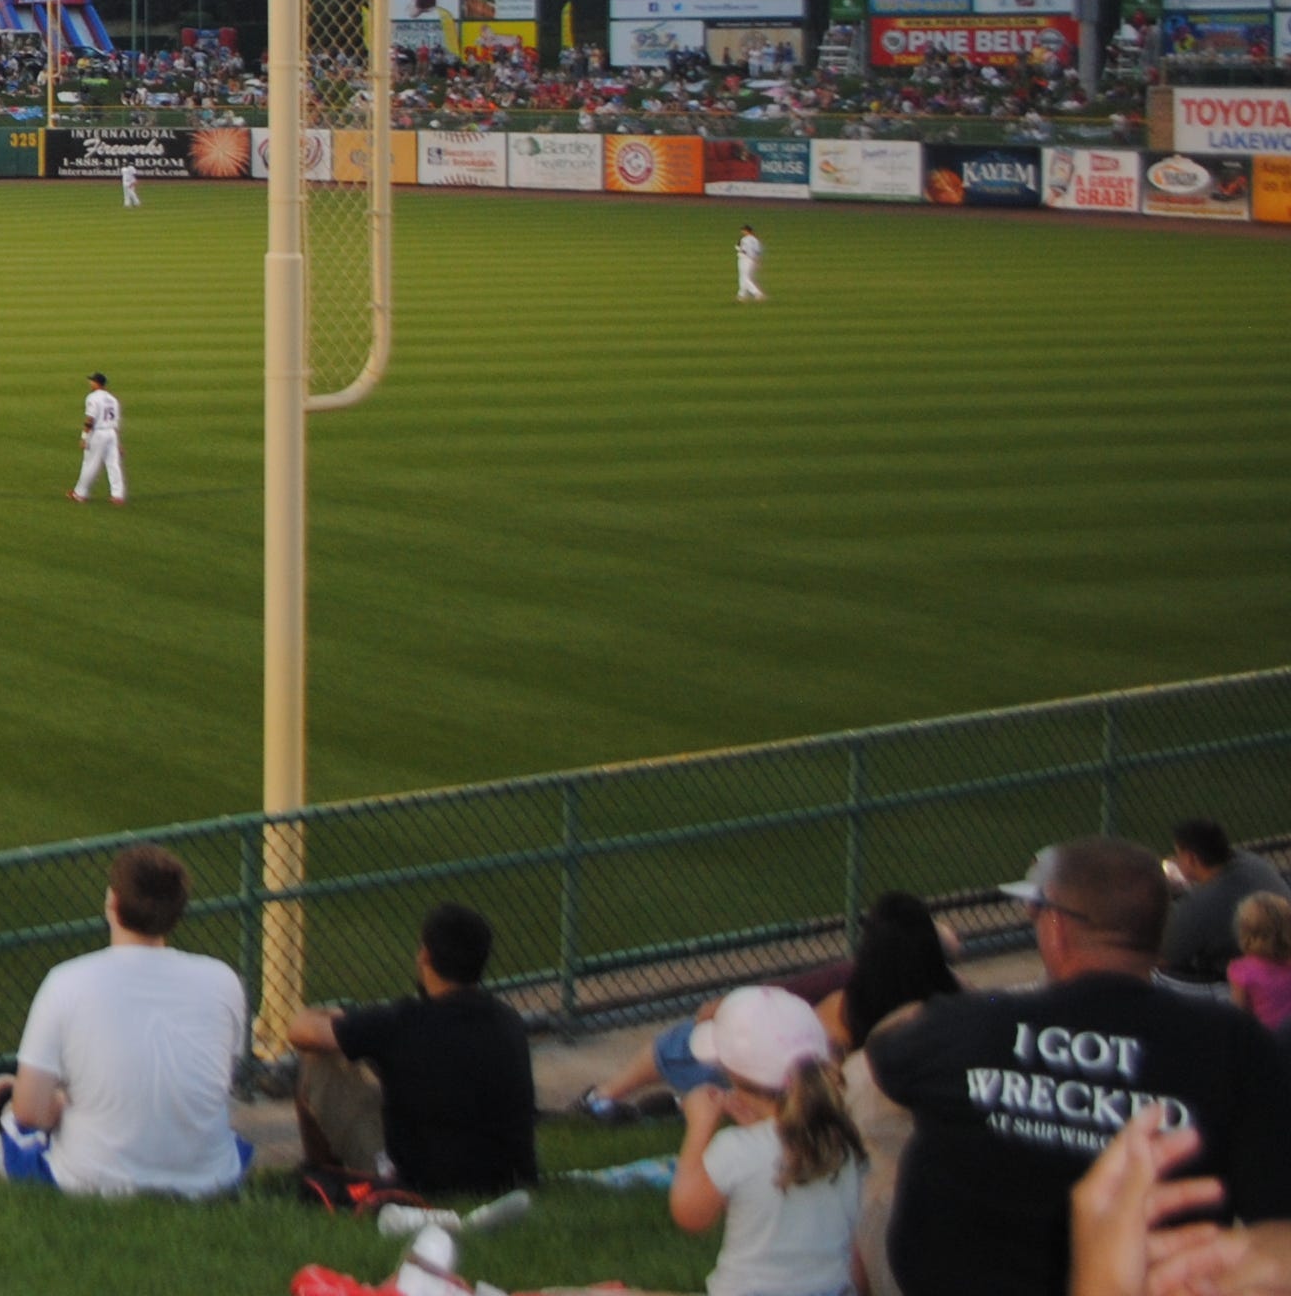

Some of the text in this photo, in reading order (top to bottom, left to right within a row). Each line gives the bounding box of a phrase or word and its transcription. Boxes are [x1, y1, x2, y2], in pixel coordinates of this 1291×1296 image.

[907, 29, 1038, 53] PINE BELT
[1181, 97, 1291, 128] TOYOTA
[10, 132, 37, 147] 325
[70, 128, 177, 139] INTERNATIONAL
[83, 137, 166, 159] Fireworks
[57, 167, 189, 177] internationalworks.com
[761, 159, 805, 175] HOUSE
[962, 160, 1037, 192] KAYEM
[1075, 175, 1134, 190] A GREAT
[1074, 188, 1133, 207] GRAB!
[1013, 1022, 1139, 1078] I GOT
[966, 1067, 1192, 1134] WRECKED
[986, 1111, 1010, 1133] AT
